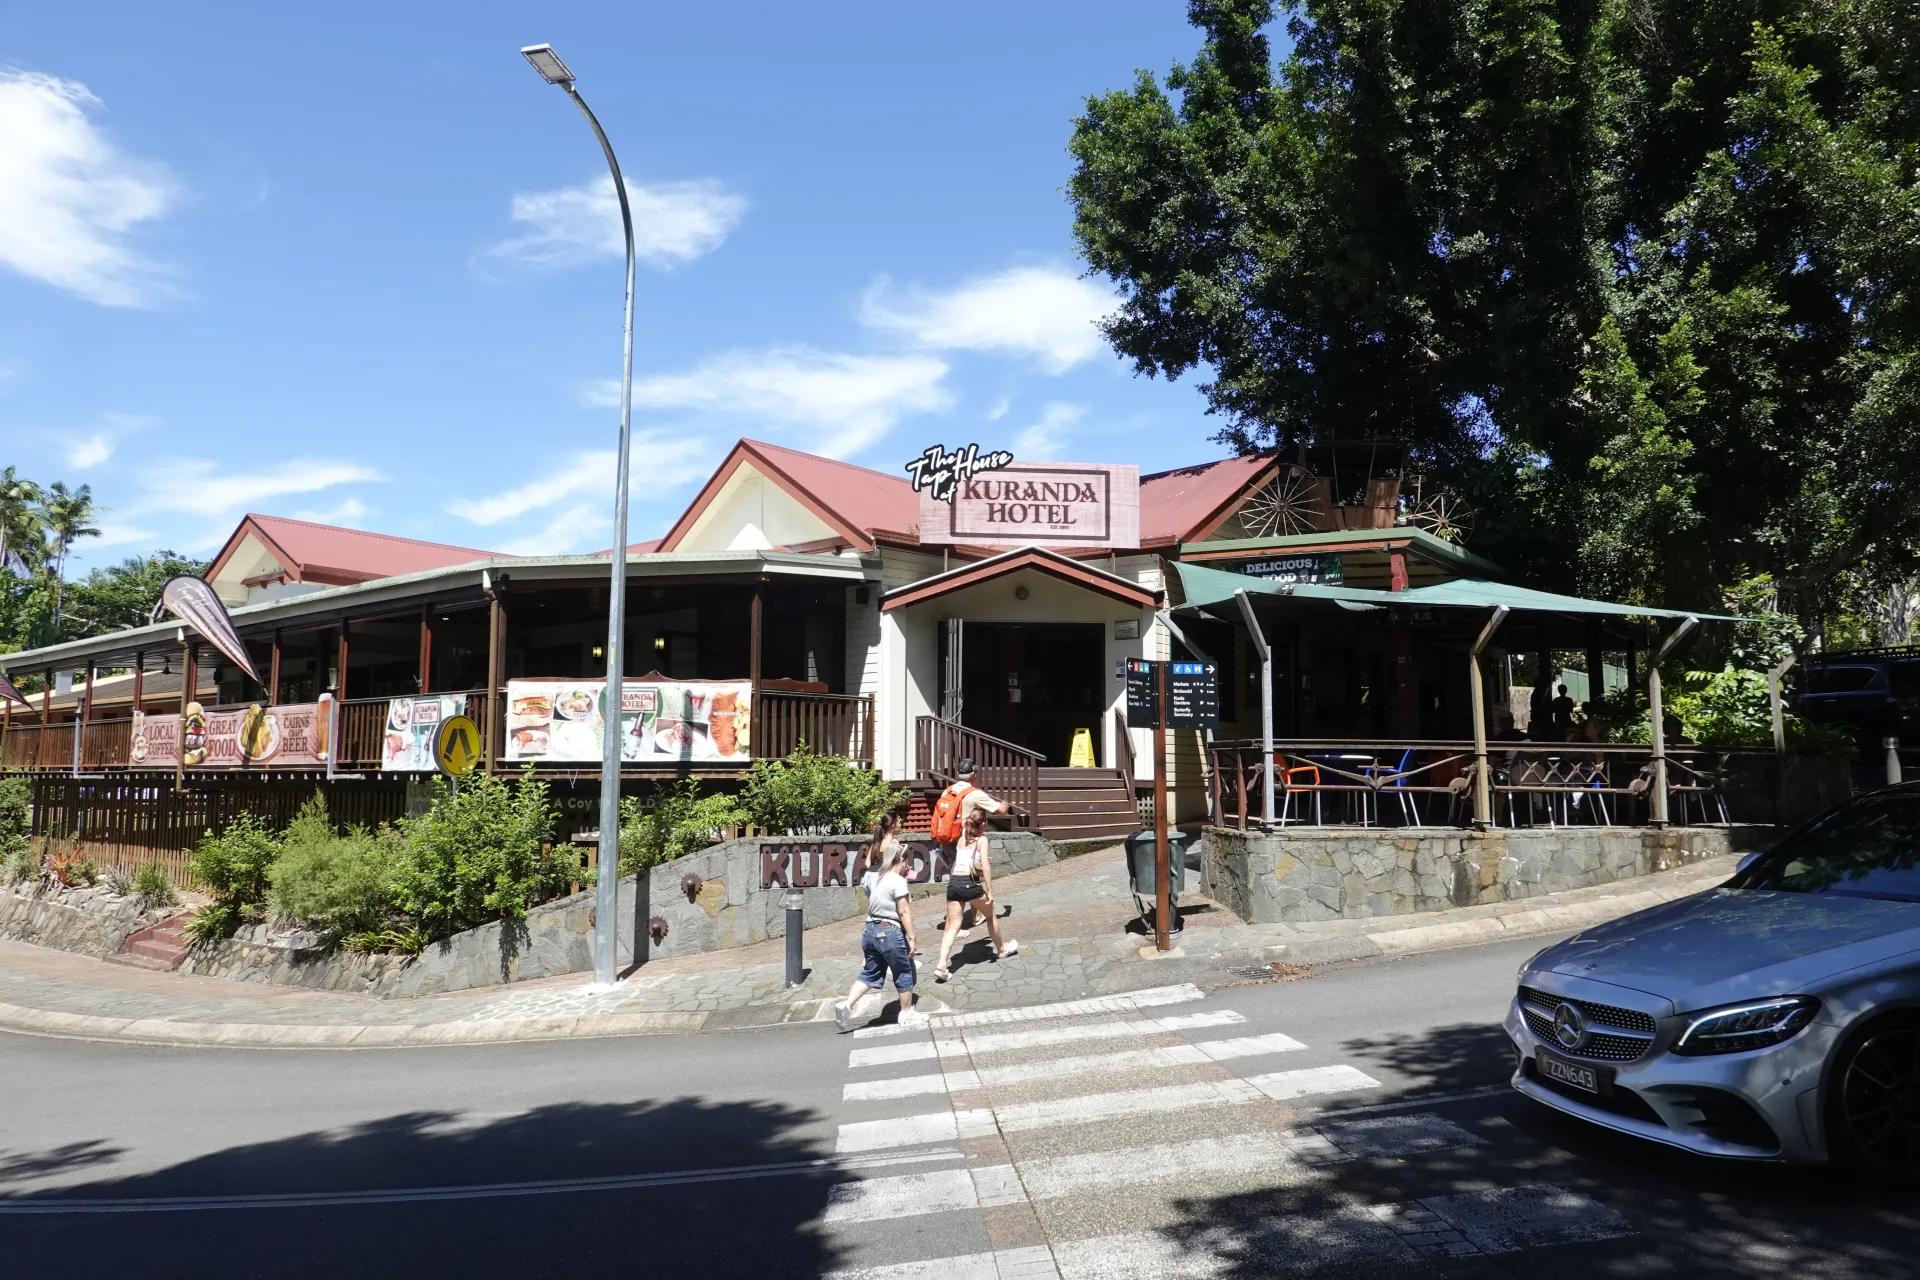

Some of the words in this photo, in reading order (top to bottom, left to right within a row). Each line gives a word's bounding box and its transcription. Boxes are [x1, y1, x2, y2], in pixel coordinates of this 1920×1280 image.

[926, 446, 957, 470] The
[907, 459, 951, 498] Tap
[952, 445, 1012, 480] House
[939, 482, 956, 503] at
[962, 479, 1099, 503] KURANDA
[986, 502, 1077, 525] HOTEL
[1245, 558, 1313, 574] DELICIOUS
[208, 719, 238, 735] GREAT
[283, 716, 310, 729] CAIRNS
[149, 724, 175, 740] LOCAL
[288, 729, 303, 738] CRAFT
[148, 742, 174, 755] COFFEE
[208, 738, 236, 757] FOOD
[282, 737, 308, 752] BEER
[553, 797, 563, 809] A
[567, 797, 593, 812] Coy
[1549, 1059, 1593, 1088] ZZN643
